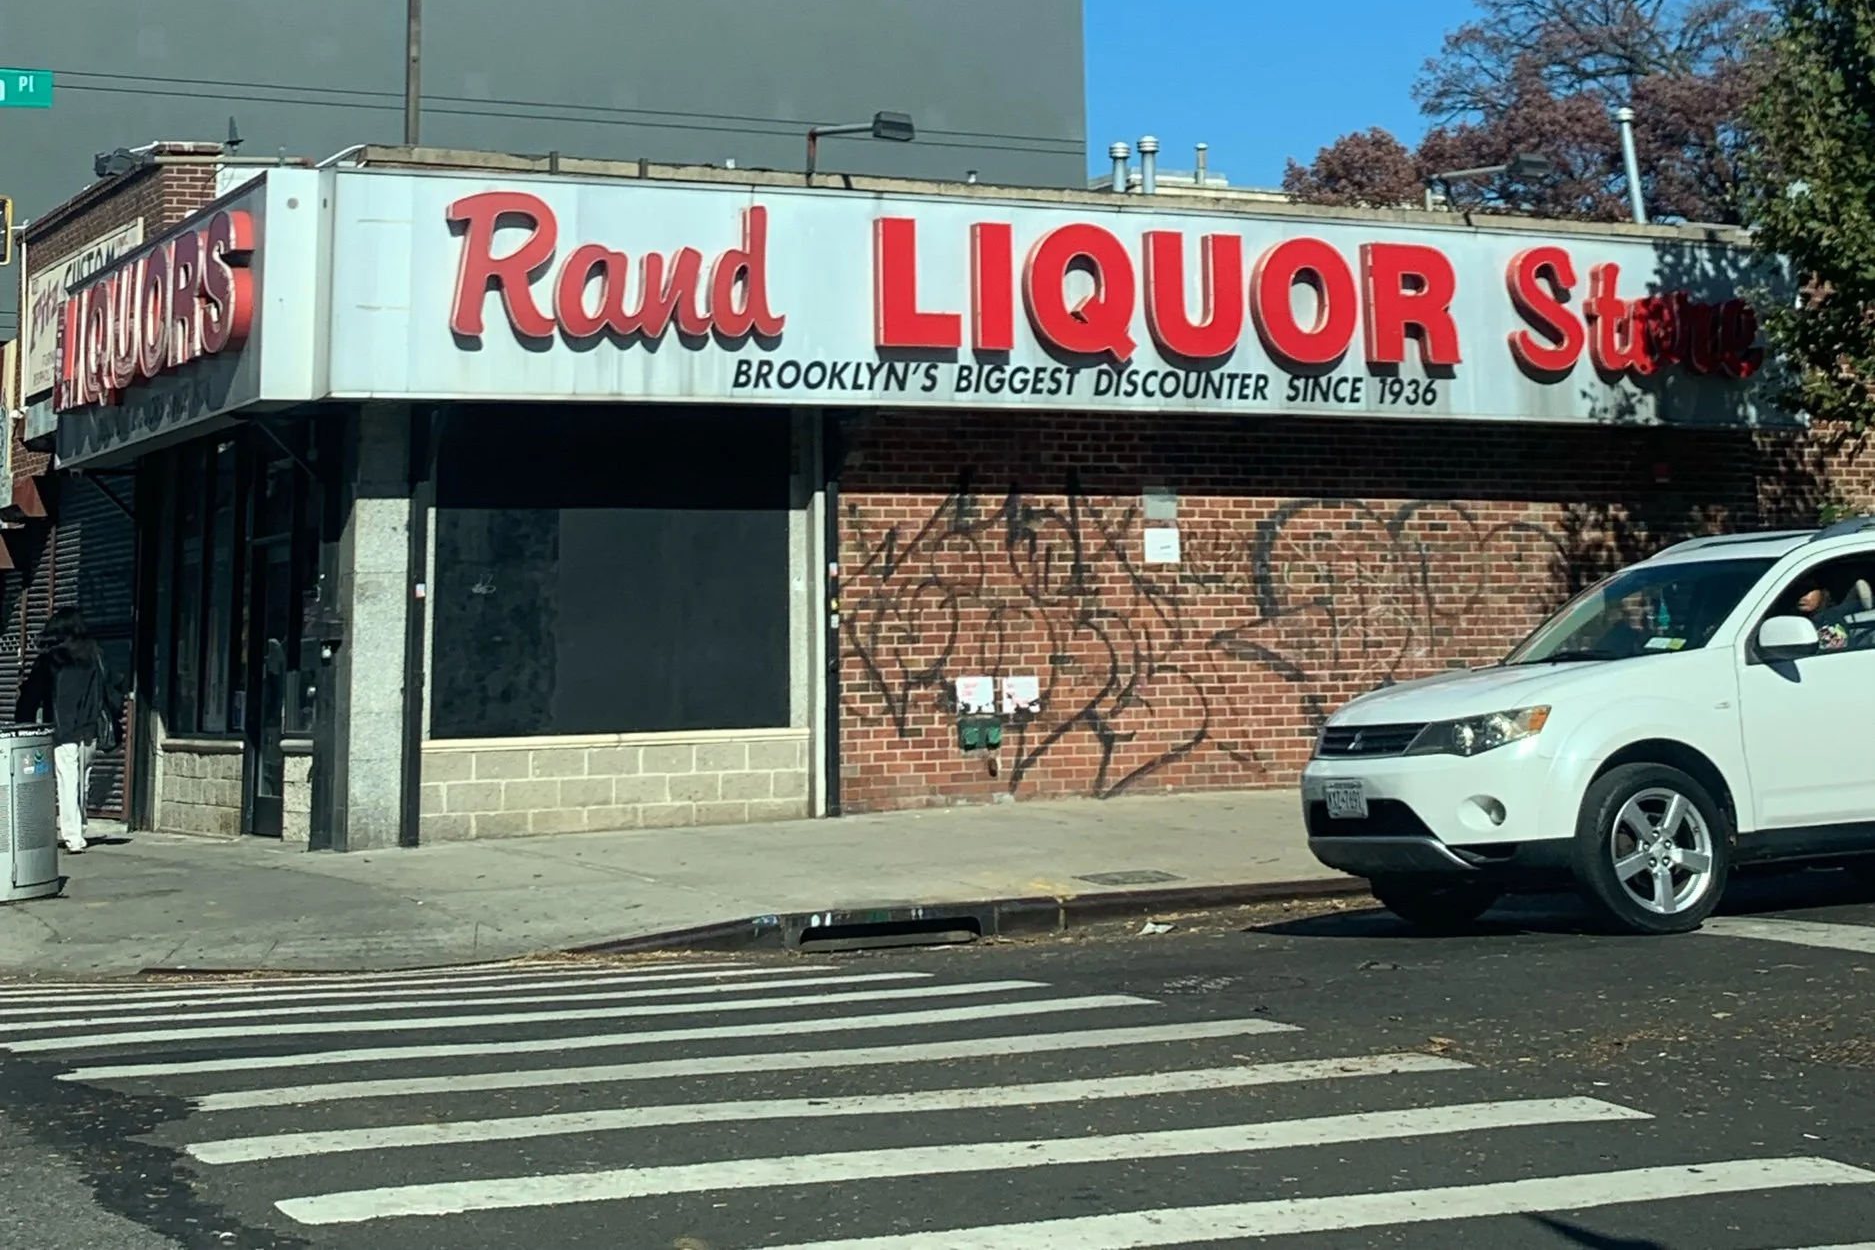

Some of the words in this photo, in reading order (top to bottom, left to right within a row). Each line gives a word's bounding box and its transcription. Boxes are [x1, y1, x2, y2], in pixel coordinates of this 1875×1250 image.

[19, 75, 34, 92] Pl
[446, 191, 786, 339] Rand
[873, 217, 1462, 365] LIQUOR
[1506, 246, 1764, 378] Store
[732, 359, 940, 392] BROOKLYN'S
[955, 364, 1083, 397] BIGGEST
[1094, 368, 1270, 401] DISCOUNTER
[1286, 374, 1364, 404] SINCE
[1378, 377, 1438, 406] 1936
